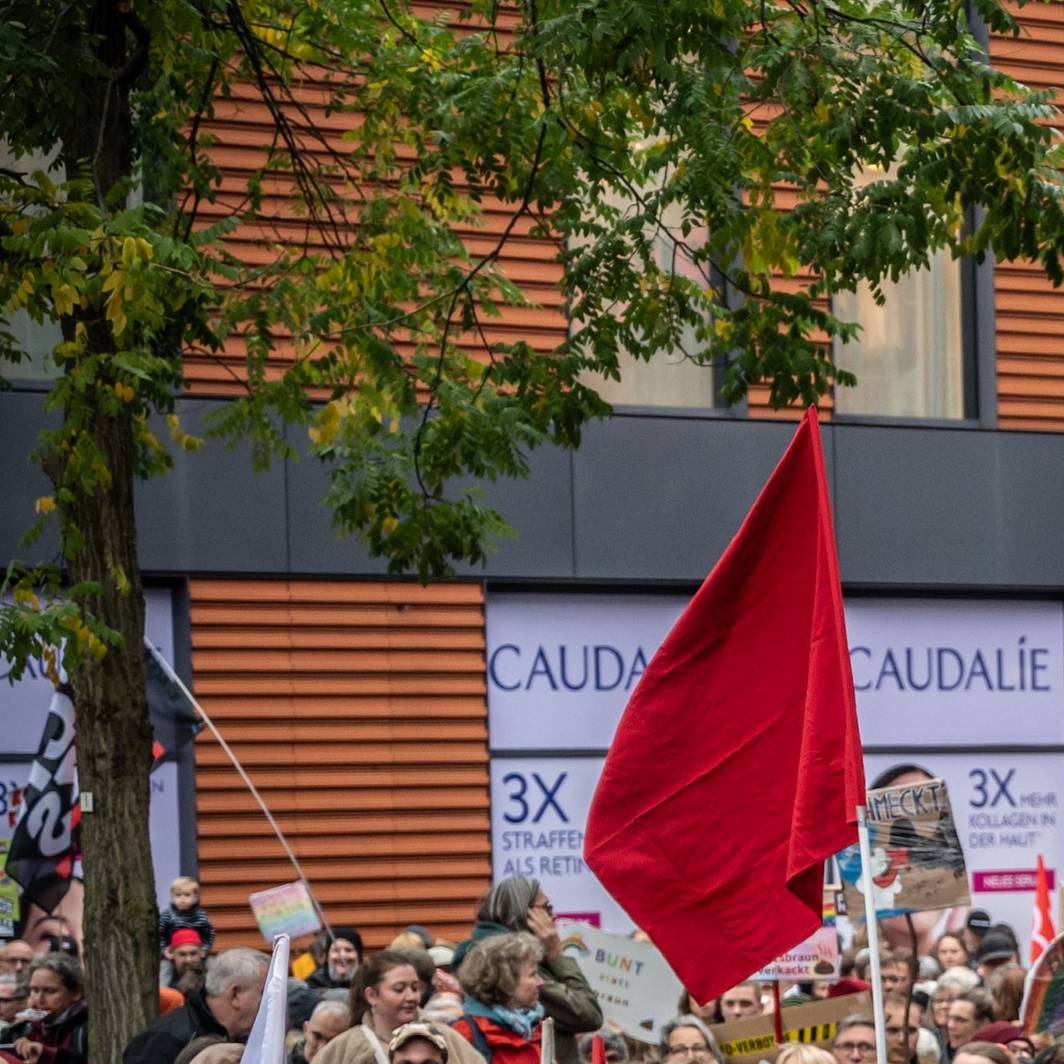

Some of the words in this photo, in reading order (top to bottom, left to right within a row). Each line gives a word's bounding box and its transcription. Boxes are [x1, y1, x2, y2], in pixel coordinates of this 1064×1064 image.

[502, 771, 570, 824] 3X
[969, 768, 1017, 808] 3X
[595, 948, 644, 975] BUNT
